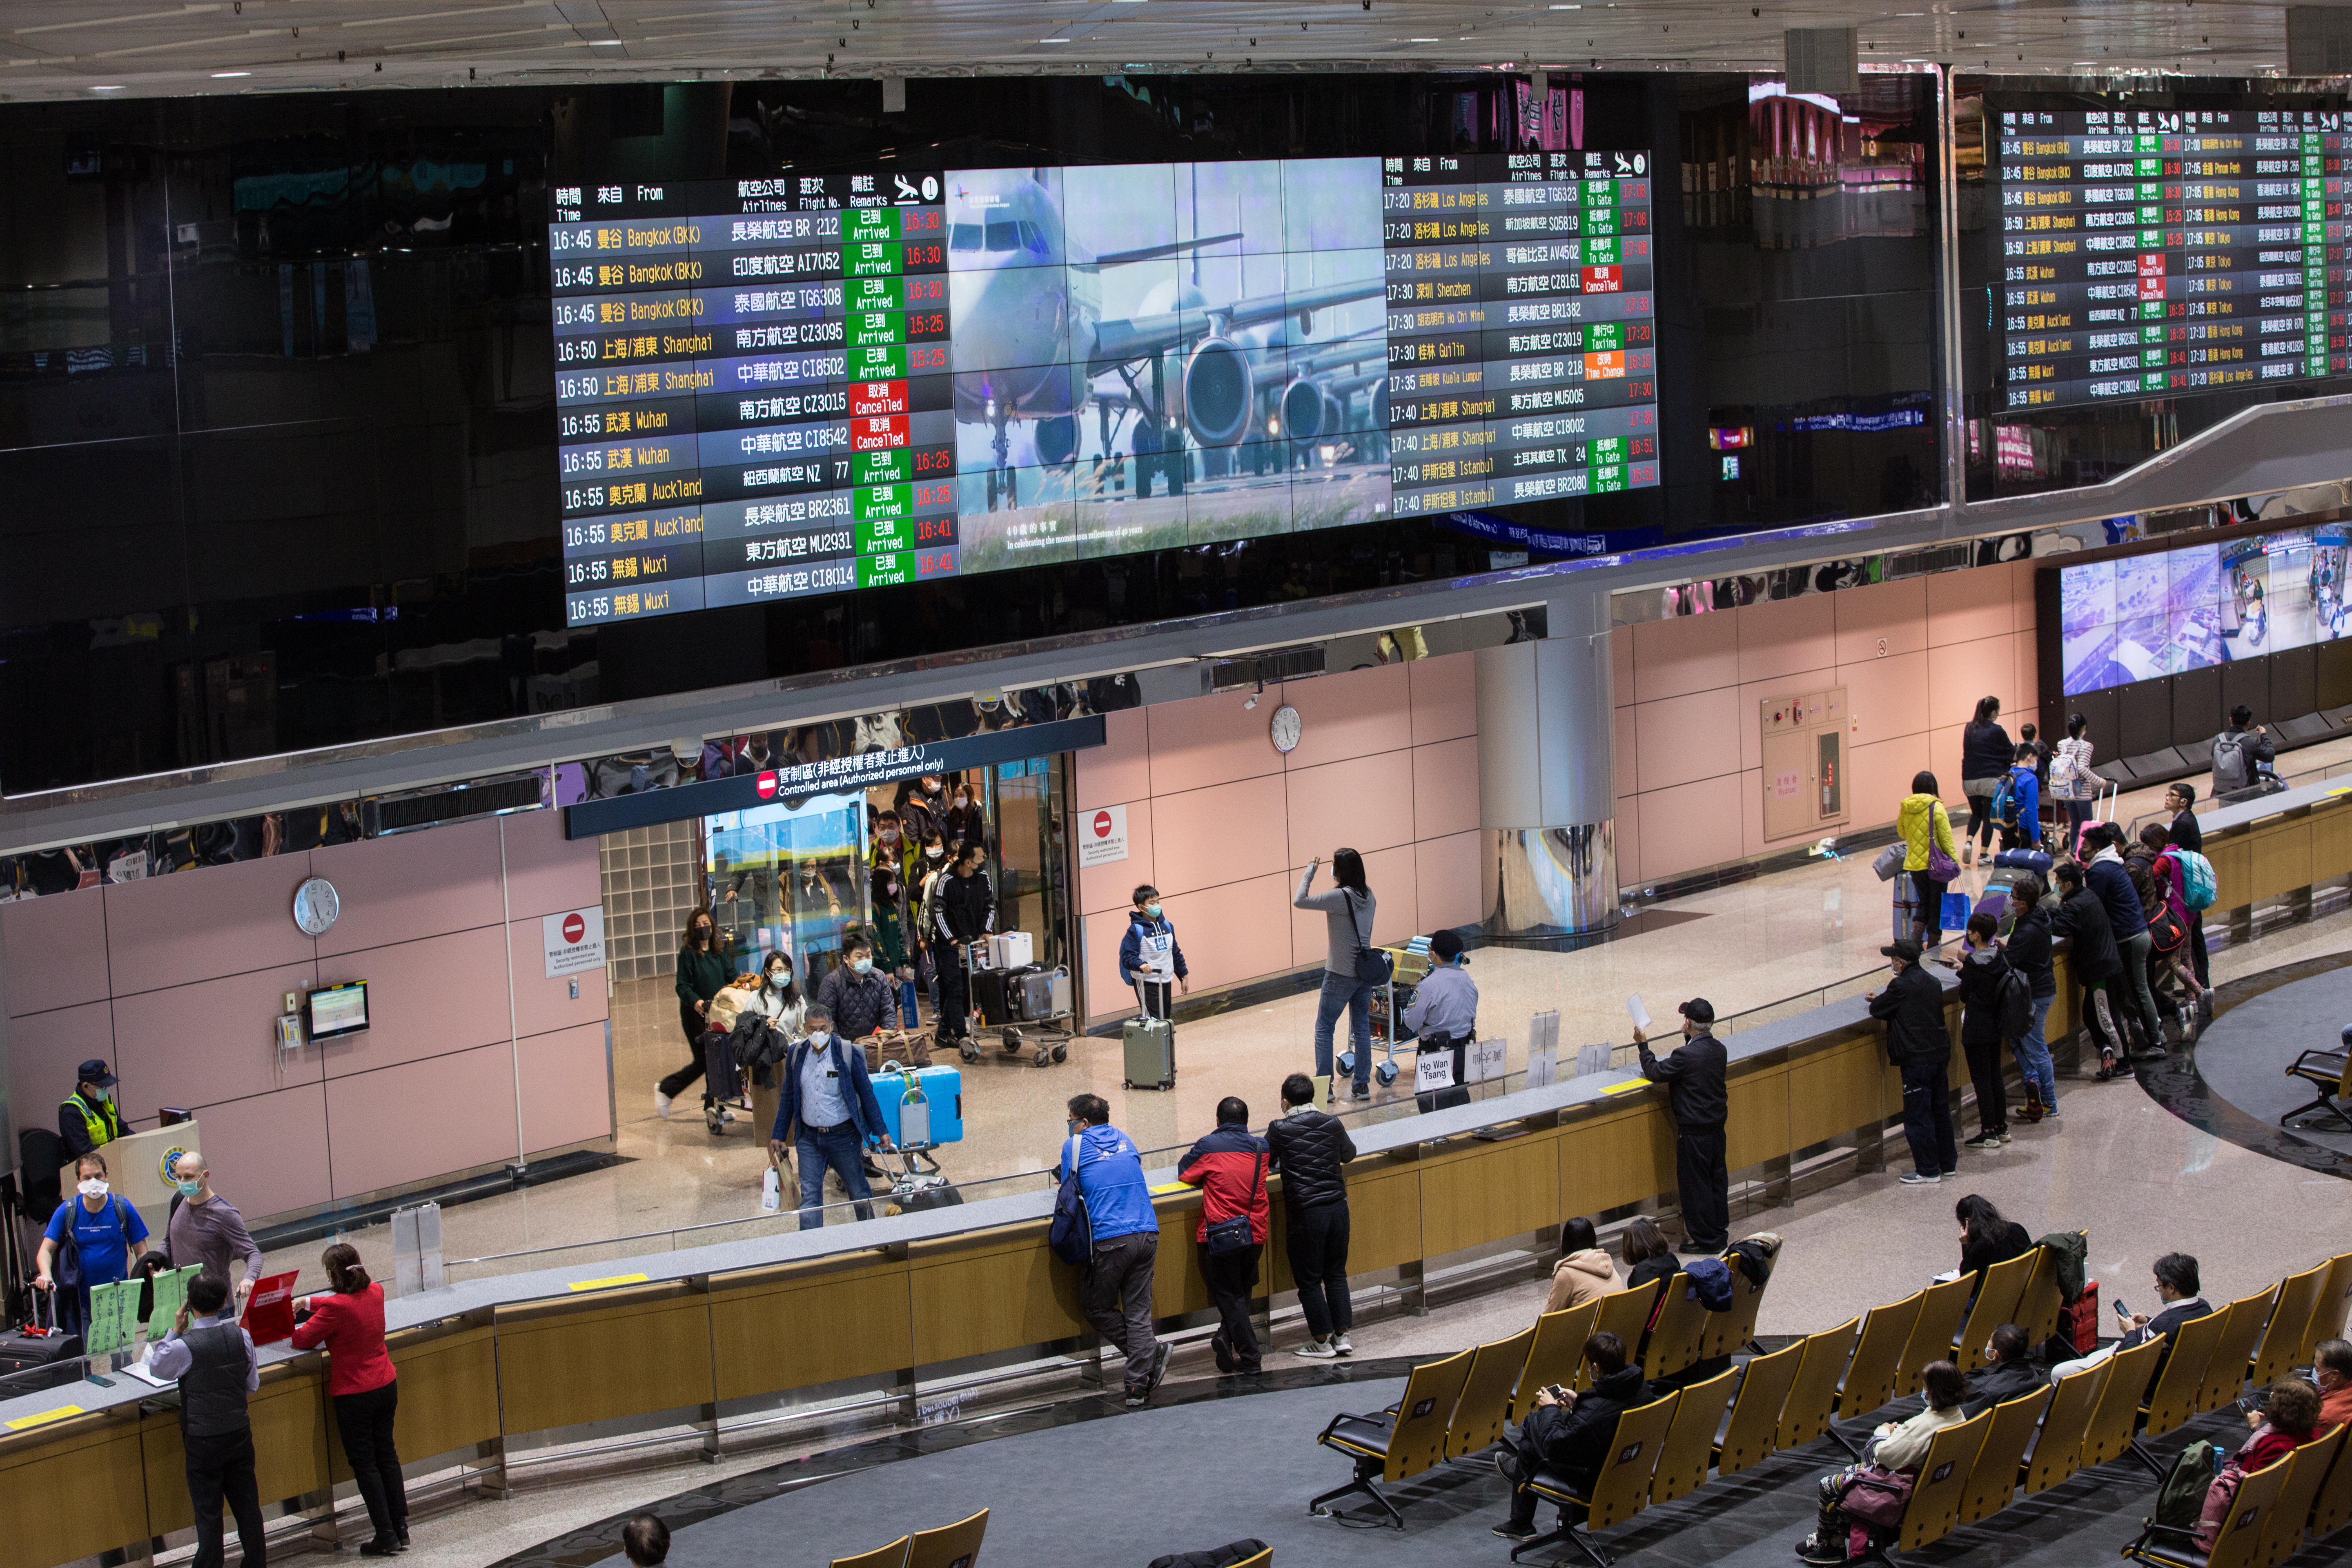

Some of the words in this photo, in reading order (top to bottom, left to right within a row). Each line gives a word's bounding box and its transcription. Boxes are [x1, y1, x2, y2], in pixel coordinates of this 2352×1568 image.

[2003, 167, 2020, 180] 16:45
[2114, 164, 2133, 176] AI7052
[557, 188, 581, 205] 時間
[598, 186, 622, 203] 來自
[638, 186, 663, 200] From
[738, 180, 784, 197] 航空公司
[800, 178, 824, 194] 班次
[851, 176, 874, 192] 備註
[2185, 186, 2201, 198] 17:05
[557, 209, 581, 221] Time
[743, 200, 786, 212] Airlines
[800, 198, 825, 209] Flight
[829, 197, 840, 208] No.
[851, 195, 887, 207] Remarks
[1385, 223, 1410, 239] 17:20
[1415, 222, 1440, 238] 洛杉磯
[1443, 223, 1456, 236] Los
[1461, 220, 1489, 237] Angeles
[1506, 217, 1547, 230] 新加坡航空
[1549, 216, 1577, 231] SQ5819
[1624, 212, 1646, 227] 17:08
[1588, 224, 1595, 234] To
[1599, 223, 1613, 233] Gate
[2005, 217, 2022, 230] 16:50
[2115, 212, 2134, 225] CZ3095
[1387, 284, 1412, 300] 17:30
[1417, 283, 1433, 299] 深圳
[1437, 282, 1470, 297] Shenzhen
[1507, 275, 1549, 293] 南方航空
[1551, 274, 1579, 289] CZ8161
[1586, 281, 1617, 292] Cancelled
[2189, 303, 2205, 315] 17:05
[865, 313, 885, 328] 已到
[559, 341, 596, 361] 16:50
[603, 336, 657, 359] 上海/浦東
[664, 333, 711, 353] Shanghai
[736, 325, 797, 348] 南方航空
[801, 323, 842, 342] CZ3095
[911, 315, 943, 334] 15:25
[858, 329, 893, 344] Arrived
[1389, 345, 1414, 362] 17:30
[1419, 343, 1435, 360] 桂林
[1439, 342, 1464, 357] Guilin
[1509, 334, 1551, 352] 南方航空
[1553, 332, 1581, 347] CZ3019
[1628, 326, 1649, 341] 17:20
[1592, 338, 1616, 349] Taxiing
[2009, 367, 2026, 381] 16:55
[2119, 356, 2138, 369] MU2931
[868, 383, 888, 398] 取消
[856, 398, 902, 414] Cancelled
[1391, 405, 1416, 422] 17:40
[1421, 401, 1458, 419] 上海/浦東
[1462, 398, 1494, 415] Shanghai
[1511, 392, 1553, 410] 東方航空
[1555, 389, 1584, 405] MU5005
[1629, 382, 1651, 397] 17:30
[563, 414, 600, 435] 16:55
[606, 412, 630, 432] 武漢
[636, 411, 667, 429] Wuhan
[739, 396, 800, 420] 南方航空
[804, 392, 846, 413] CZ3015
[873, 486, 893, 501] 已到
[568, 524, 605, 546] 16:55
[611, 520, 647, 543] 奧克蘭
[655, 514, 703, 536] Auckland
[745, 502, 805, 526] 長榮航空
[809, 497, 850, 518] BR2361
[918, 486, 950, 506] 16:25
[866, 502, 901, 518] Arrived
[874, 520, 894, 536] 已到
[867, 536, 902, 552] Arrived
[1007, 541, 1013, 549] In
[1014, 538, 1045, 549] celebrating
[1046, 536, 1055, 544] the
[1056, 534, 1087, 542] momentous
[1088, 530, 1114, 539] milestone
[1115, 527, 1121, 536] of
[1121, 528, 1128, 537] 40
[1128, 526, 1142, 536] years
[569, 561, 606, 583] 16:55
[612, 557, 637, 579] 無錫
[643, 555, 666, 574] Wuxi
[746, 537, 807, 561] 東方航空
[810, 532, 852, 553] MU2931
[919, 520, 951, 539] 16:41
[779, 779, 819, 796] Controlled
[822, 780, 838, 789] area
[840, 770, 884, 787] (Authorized
[886, 761, 923, 780] personnel
[925, 758, 943, 771] only)
[1778, 787, 1796, 796] Hydrant
[575, 958, 592, 966] personnel
[1421, 1063, 1430, 1071] Ho
[1433, 1060, 1448, 1069] Wan
[1424, 1070, 1446, 1080] Tsang
